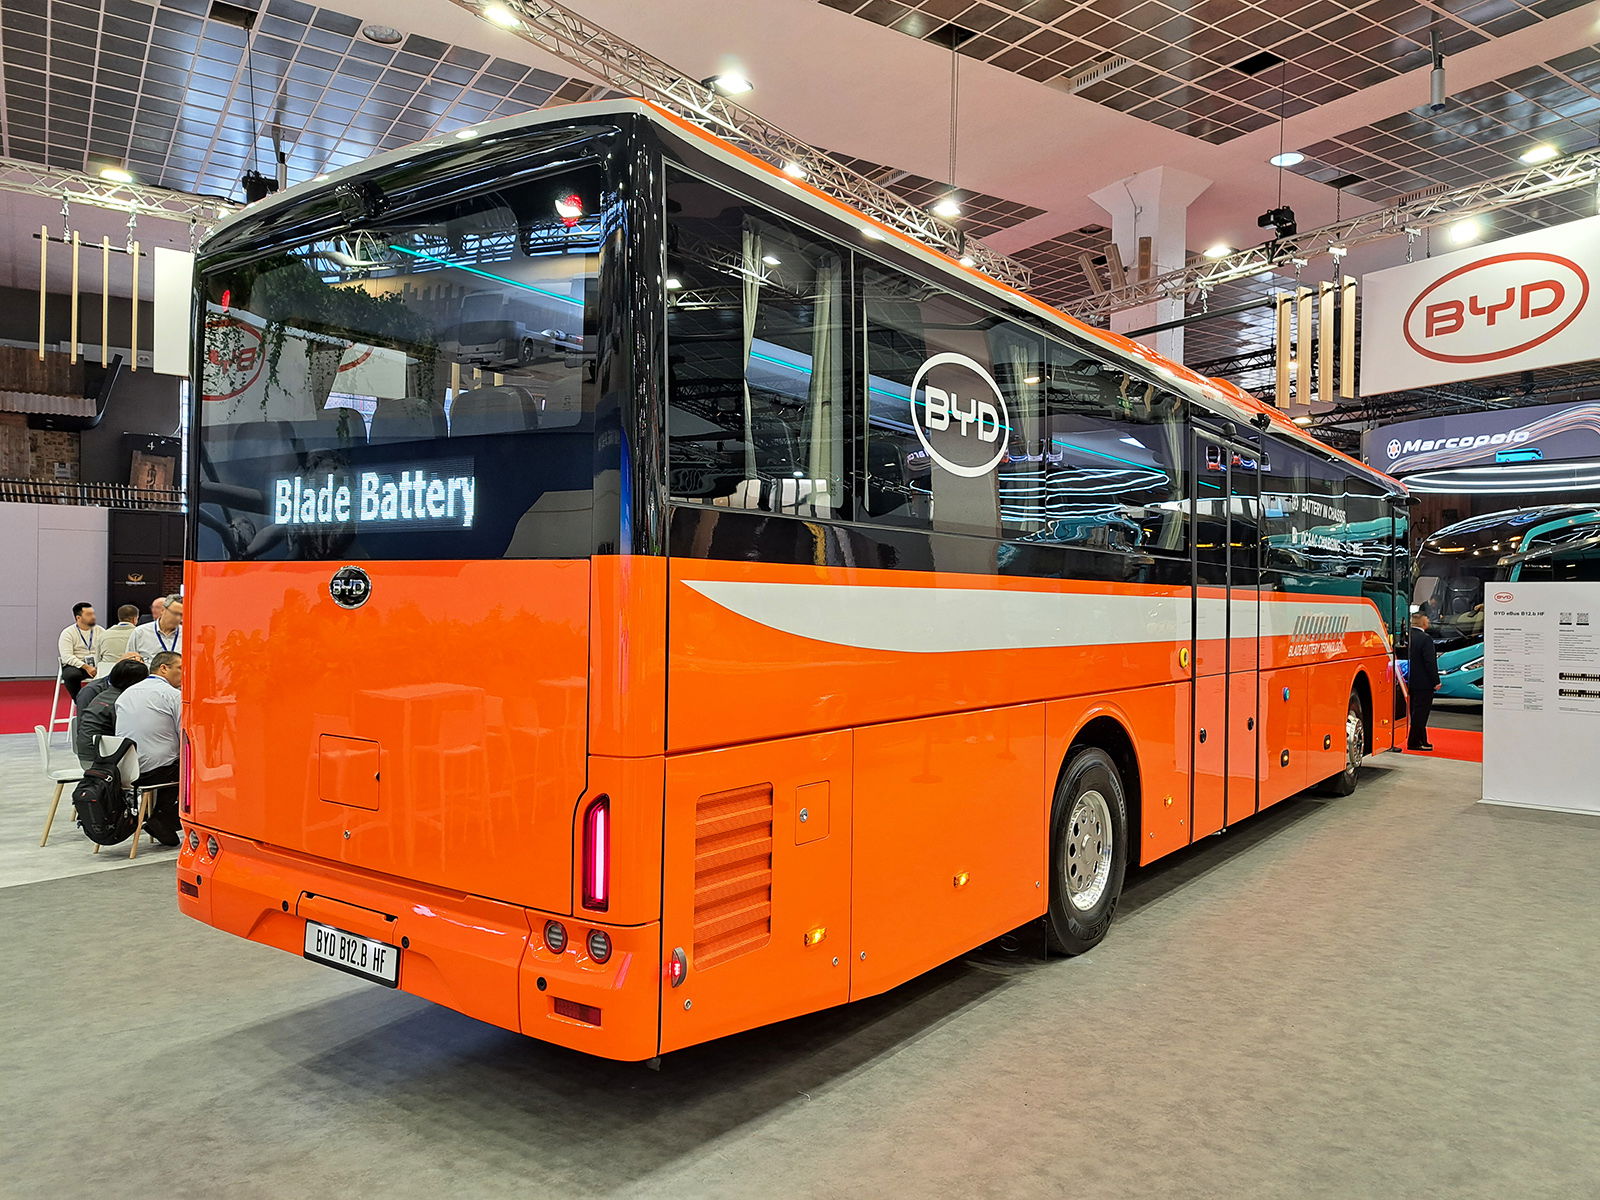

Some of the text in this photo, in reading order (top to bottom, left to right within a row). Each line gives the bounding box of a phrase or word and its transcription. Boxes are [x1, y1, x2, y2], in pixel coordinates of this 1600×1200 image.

[1424, 279, 1566, 338] BYD
[924, 384, 1000, 443] BYD
[1402, 429, 1531, 454] Marcopolo
[275, 470, 475, 527] Blade Battery
[1301, 497, 1323, 517] BATTERY
[1328, 506, 1346, 523] CHASSIS
[333, 579, 365, 595] BYD
[1288, 644, 1304, 657] BLADE
[1302, 643, 1321, 655] BATTERY
[316, 929, 387, 974] BYD B12.B HF
